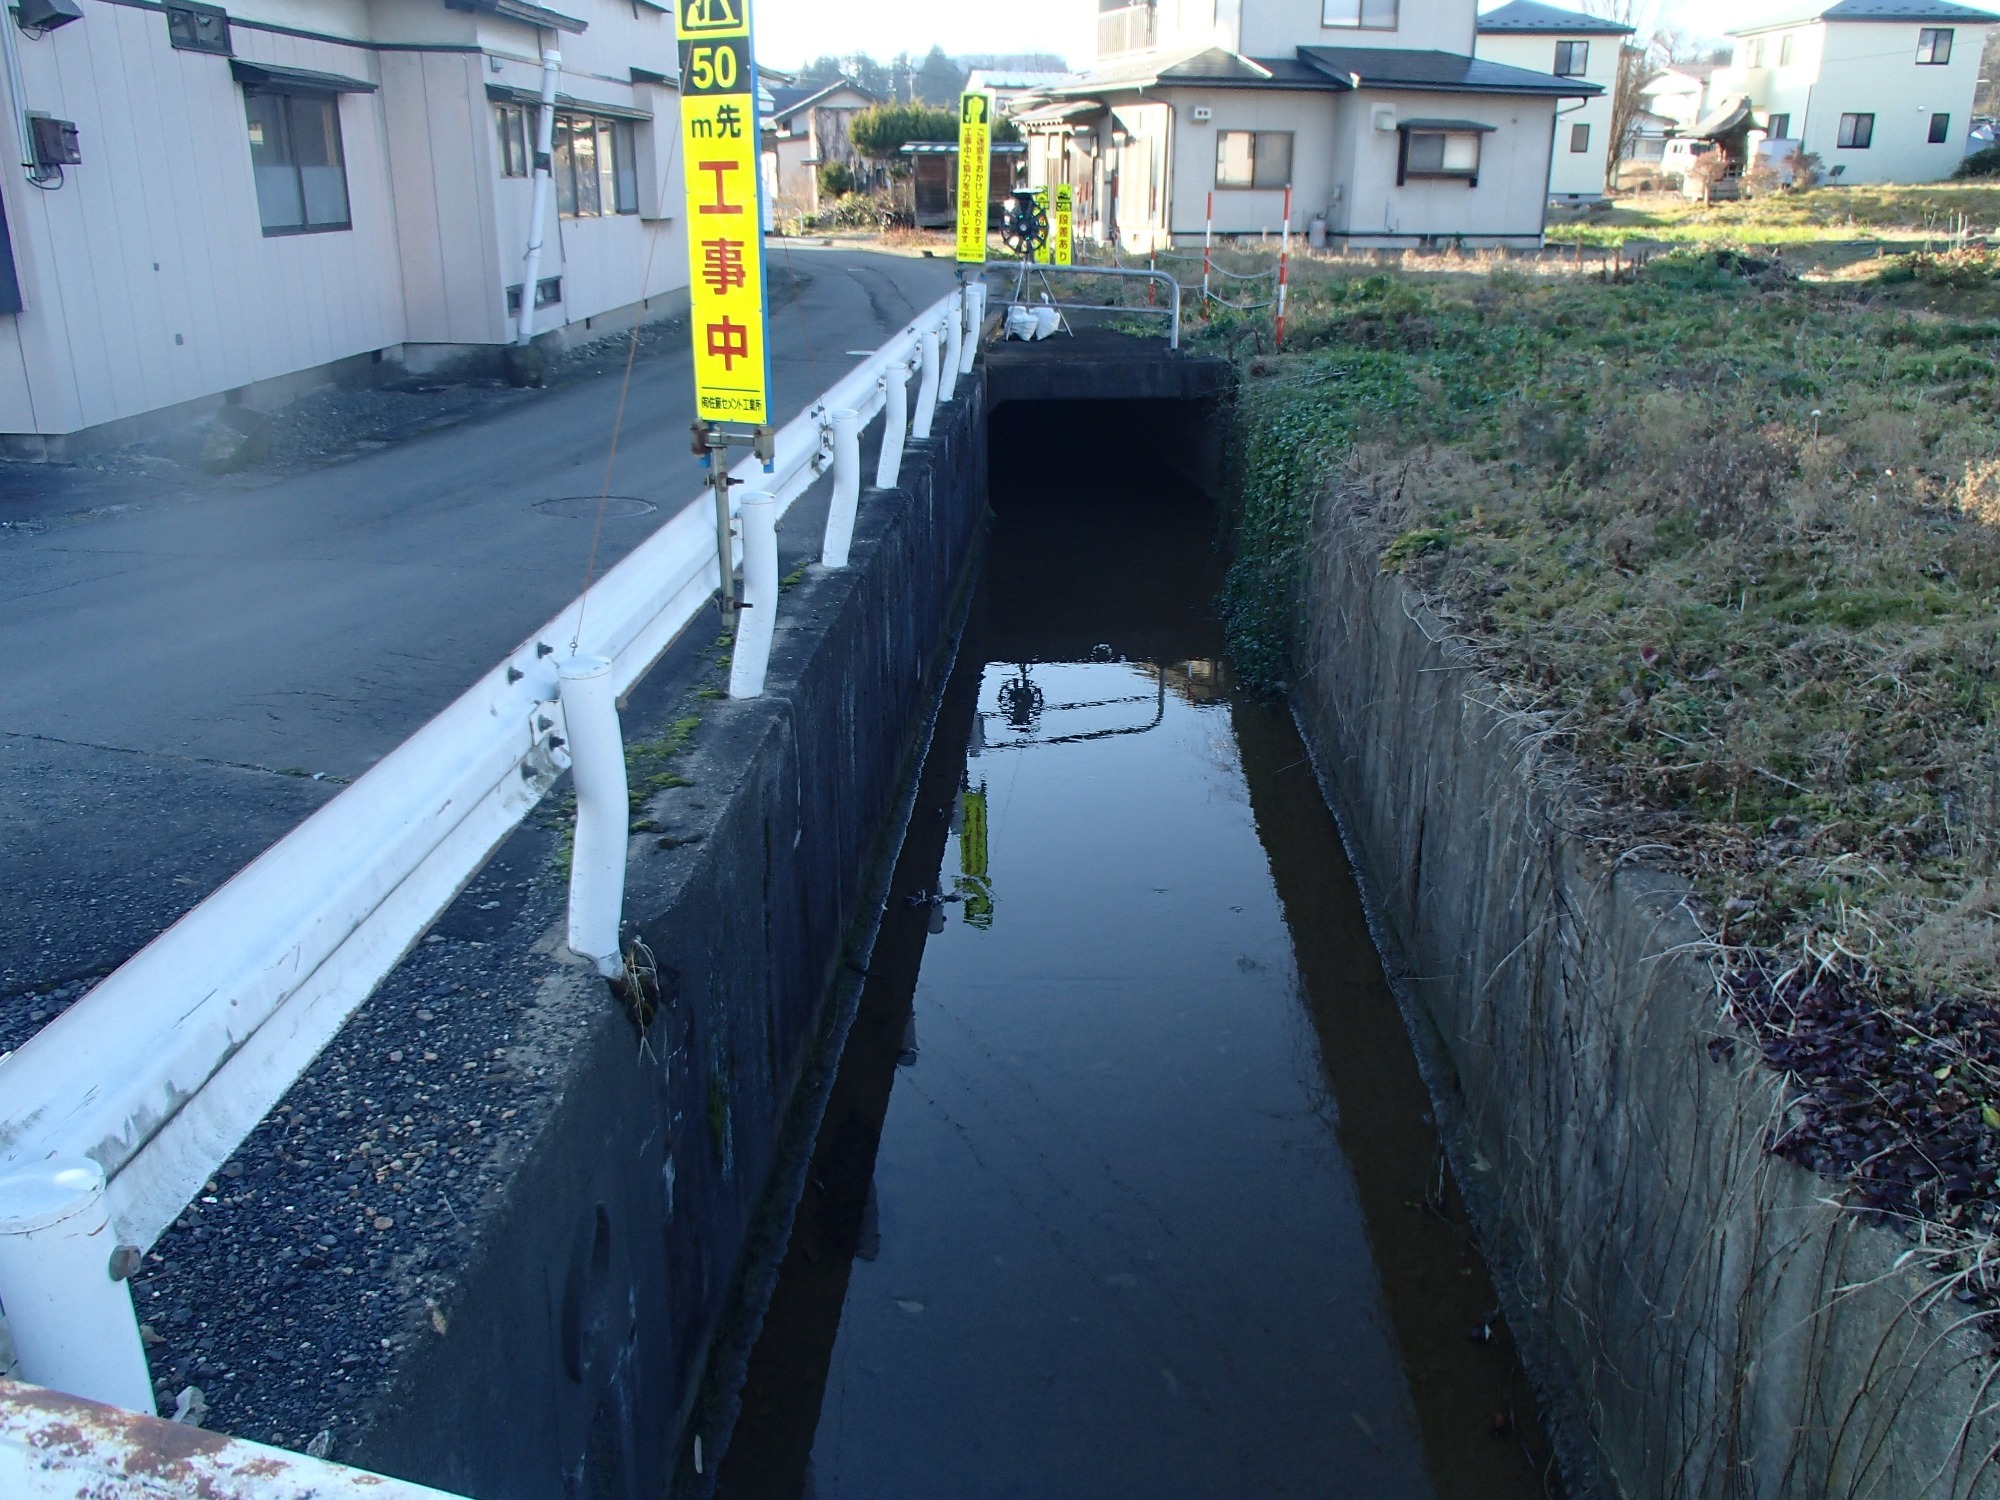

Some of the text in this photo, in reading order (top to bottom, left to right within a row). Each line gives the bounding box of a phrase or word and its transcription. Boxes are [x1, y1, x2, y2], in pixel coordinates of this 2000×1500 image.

[692, 45, 737, 89] 50
[691, 104, 741, 139] m先
[1058, 214, 1069, 262] 段差あり
[698, 160, 749, 372] 工事中
